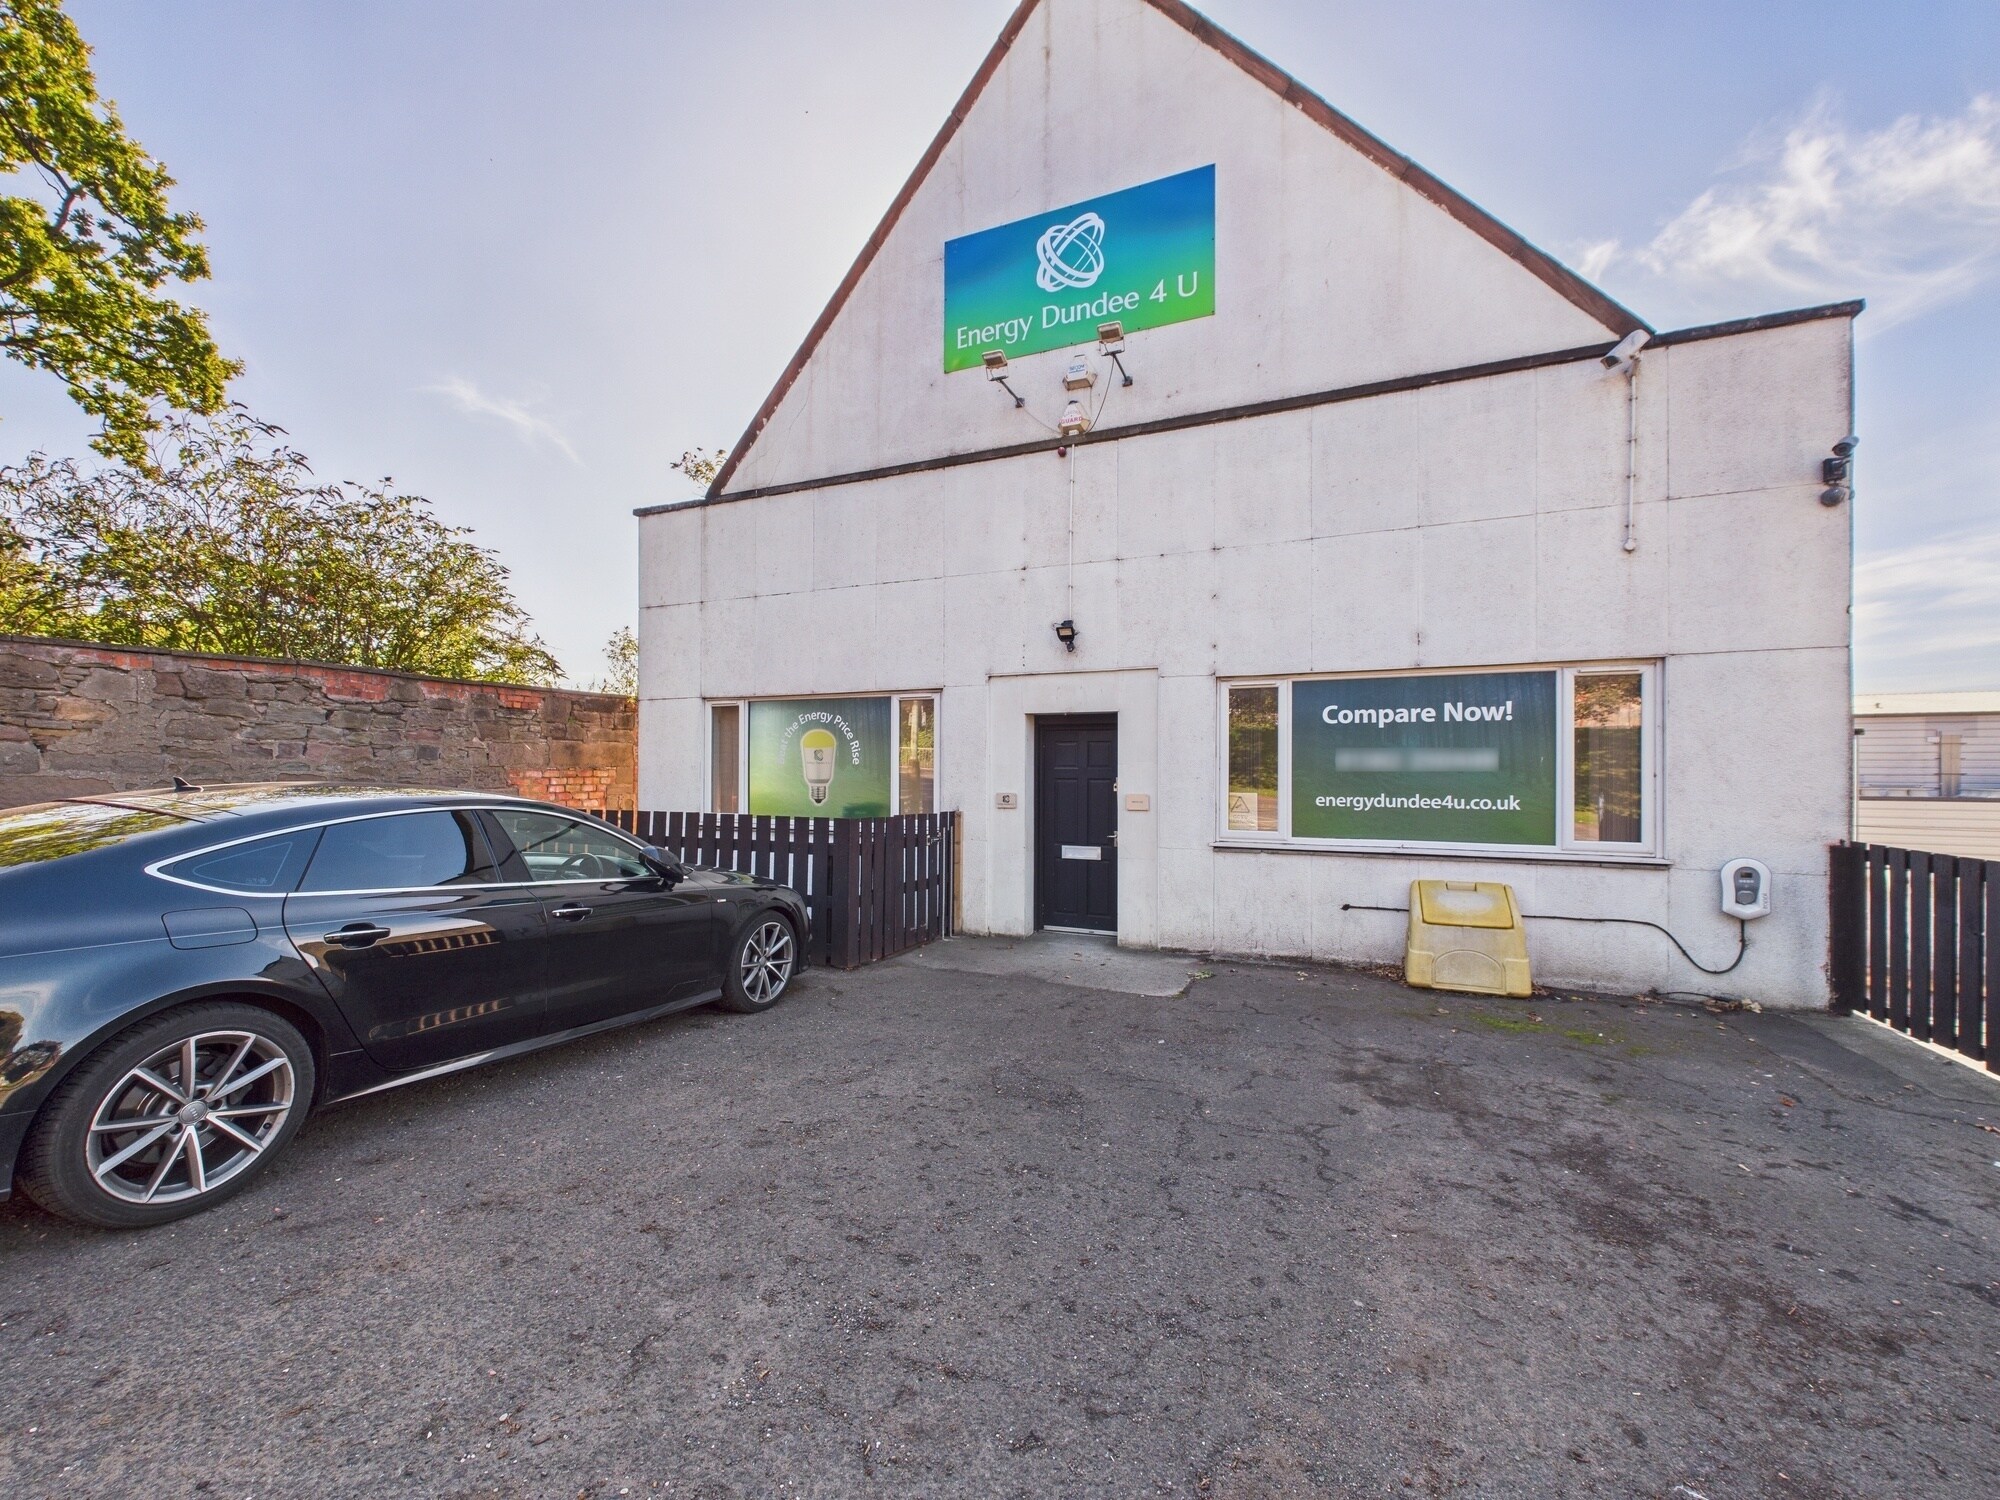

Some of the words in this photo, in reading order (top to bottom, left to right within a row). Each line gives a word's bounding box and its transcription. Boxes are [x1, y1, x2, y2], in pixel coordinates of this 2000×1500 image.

[956, 315, 1033, 350] Energy
[1041, 290, 1140, 330] Dundee
[1149, 278, 1167, 304] 4
[1177, 271, 1198, 298] U
[1322, 705, 1436, 728] Compare
[1444, 700, 1513, 722] Now!
[784, 721, 800, 738] the
[798, 711, 834, 725] Energy
[833, 715, 854, 740] Price
[850, 740, 861, 766] Rise
[1315, 792, 1521, 811] energydundee4u.co.uk
